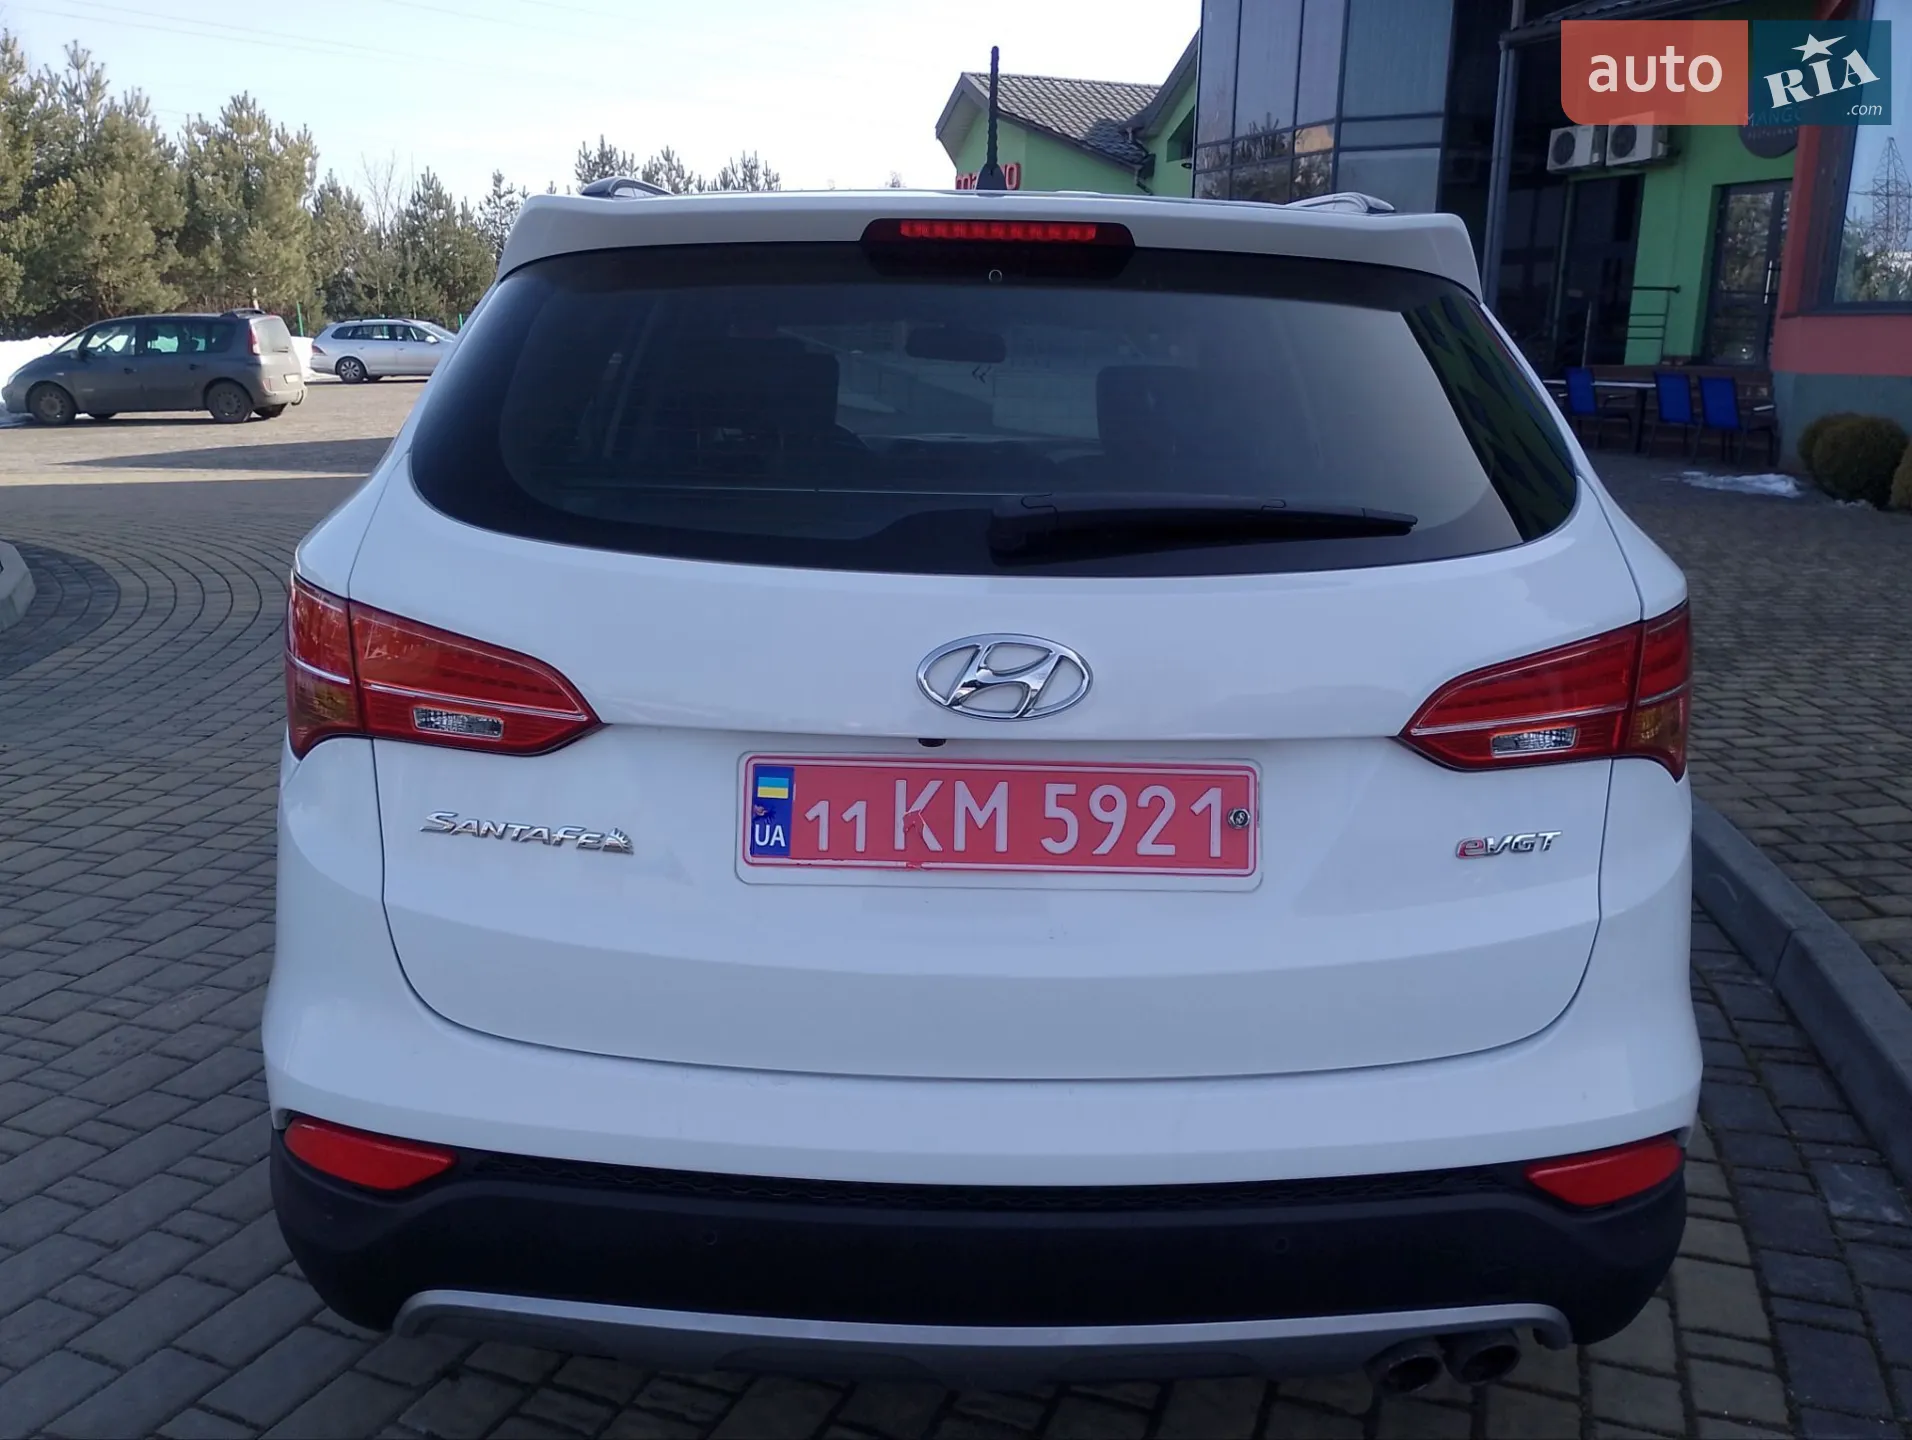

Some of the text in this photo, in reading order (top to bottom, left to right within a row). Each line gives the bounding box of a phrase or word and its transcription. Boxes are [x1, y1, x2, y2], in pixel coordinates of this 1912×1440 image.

[804, 779, 1223, 858] 11 KM 5921
[755, 824, 786, 847] UA
[1456, 830, 1563, 859] eVGT
